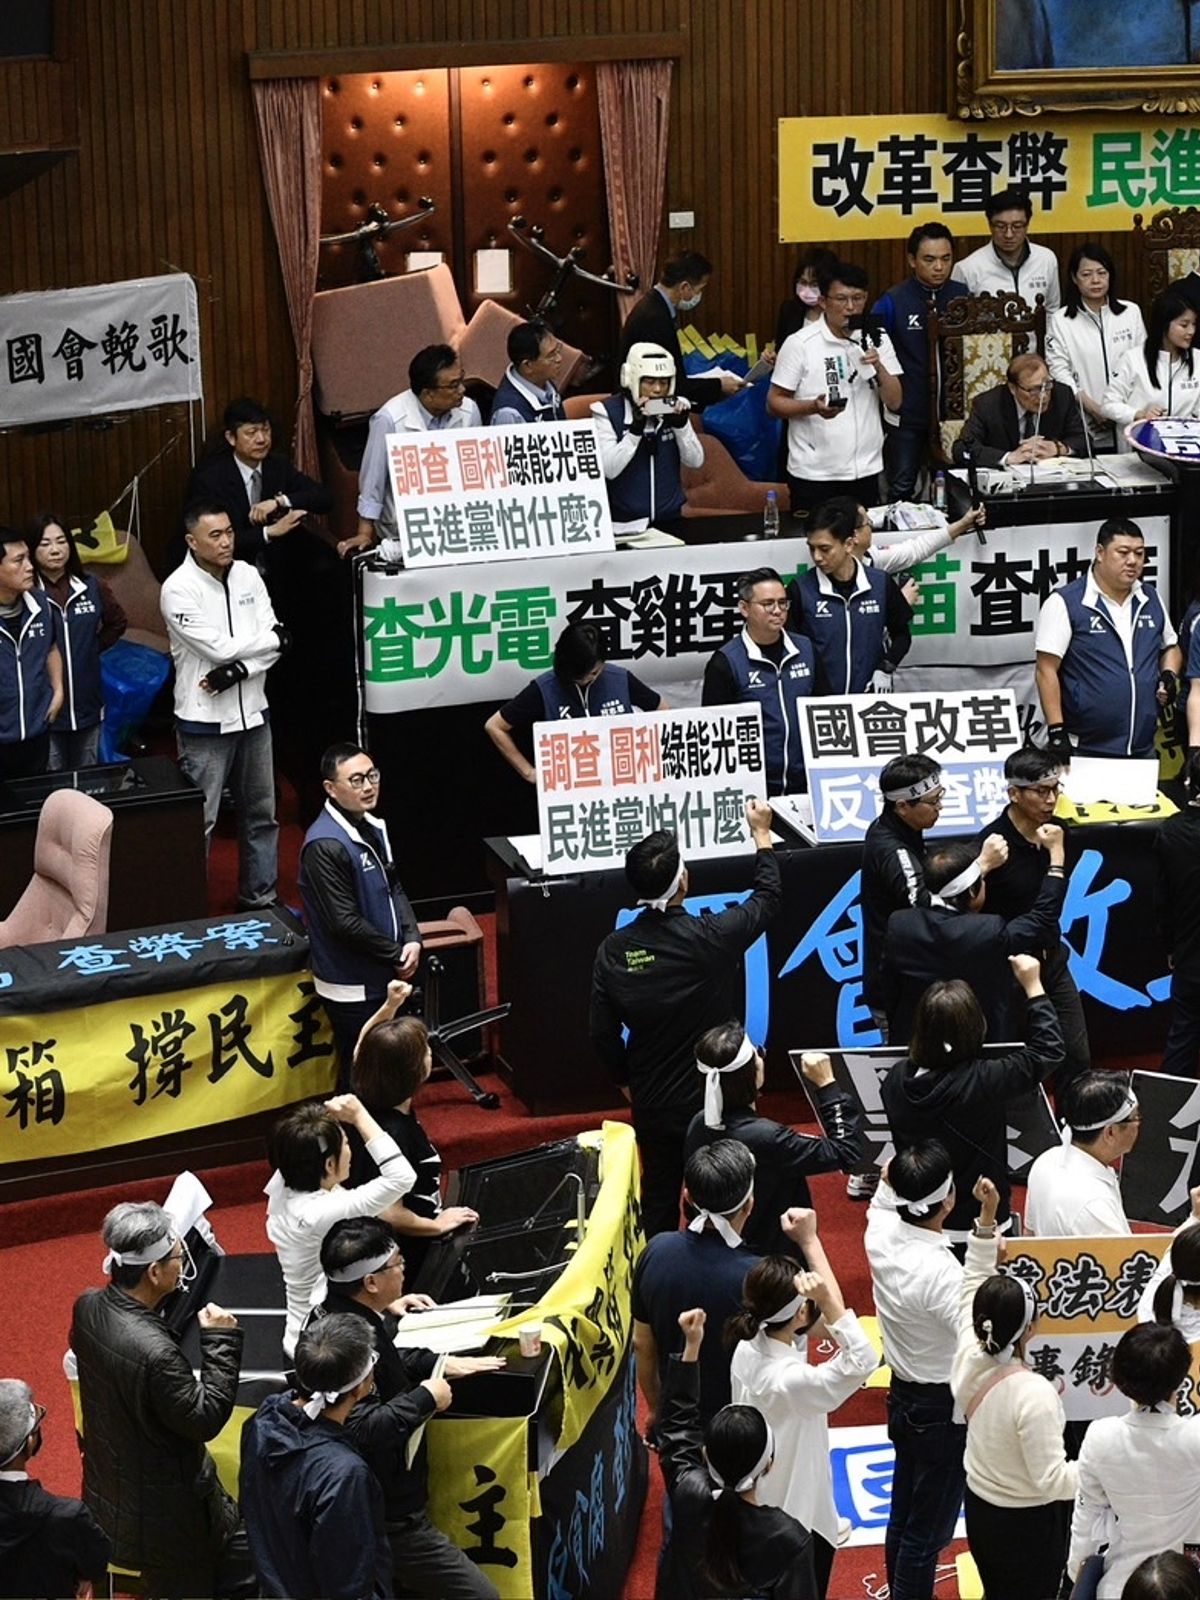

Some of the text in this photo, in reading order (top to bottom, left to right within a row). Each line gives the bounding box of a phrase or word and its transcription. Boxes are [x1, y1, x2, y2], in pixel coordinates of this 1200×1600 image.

[811, 131, 1069, 218] 改革查弊
[391, 429, 602, 497] 調查 圖利綠能光電
[403, 493, 604, 559] 民進黨怕什麼?
[364, 585, 557, 685] 查光電
[539, 714, 763, 793] 調查 圖利綠能光電
[806, 695, 1018, 759] 國會改革
[547, 787, 757, 863] 民進黨怕什麼
[819, 767, 1012, 832] 反查弊
